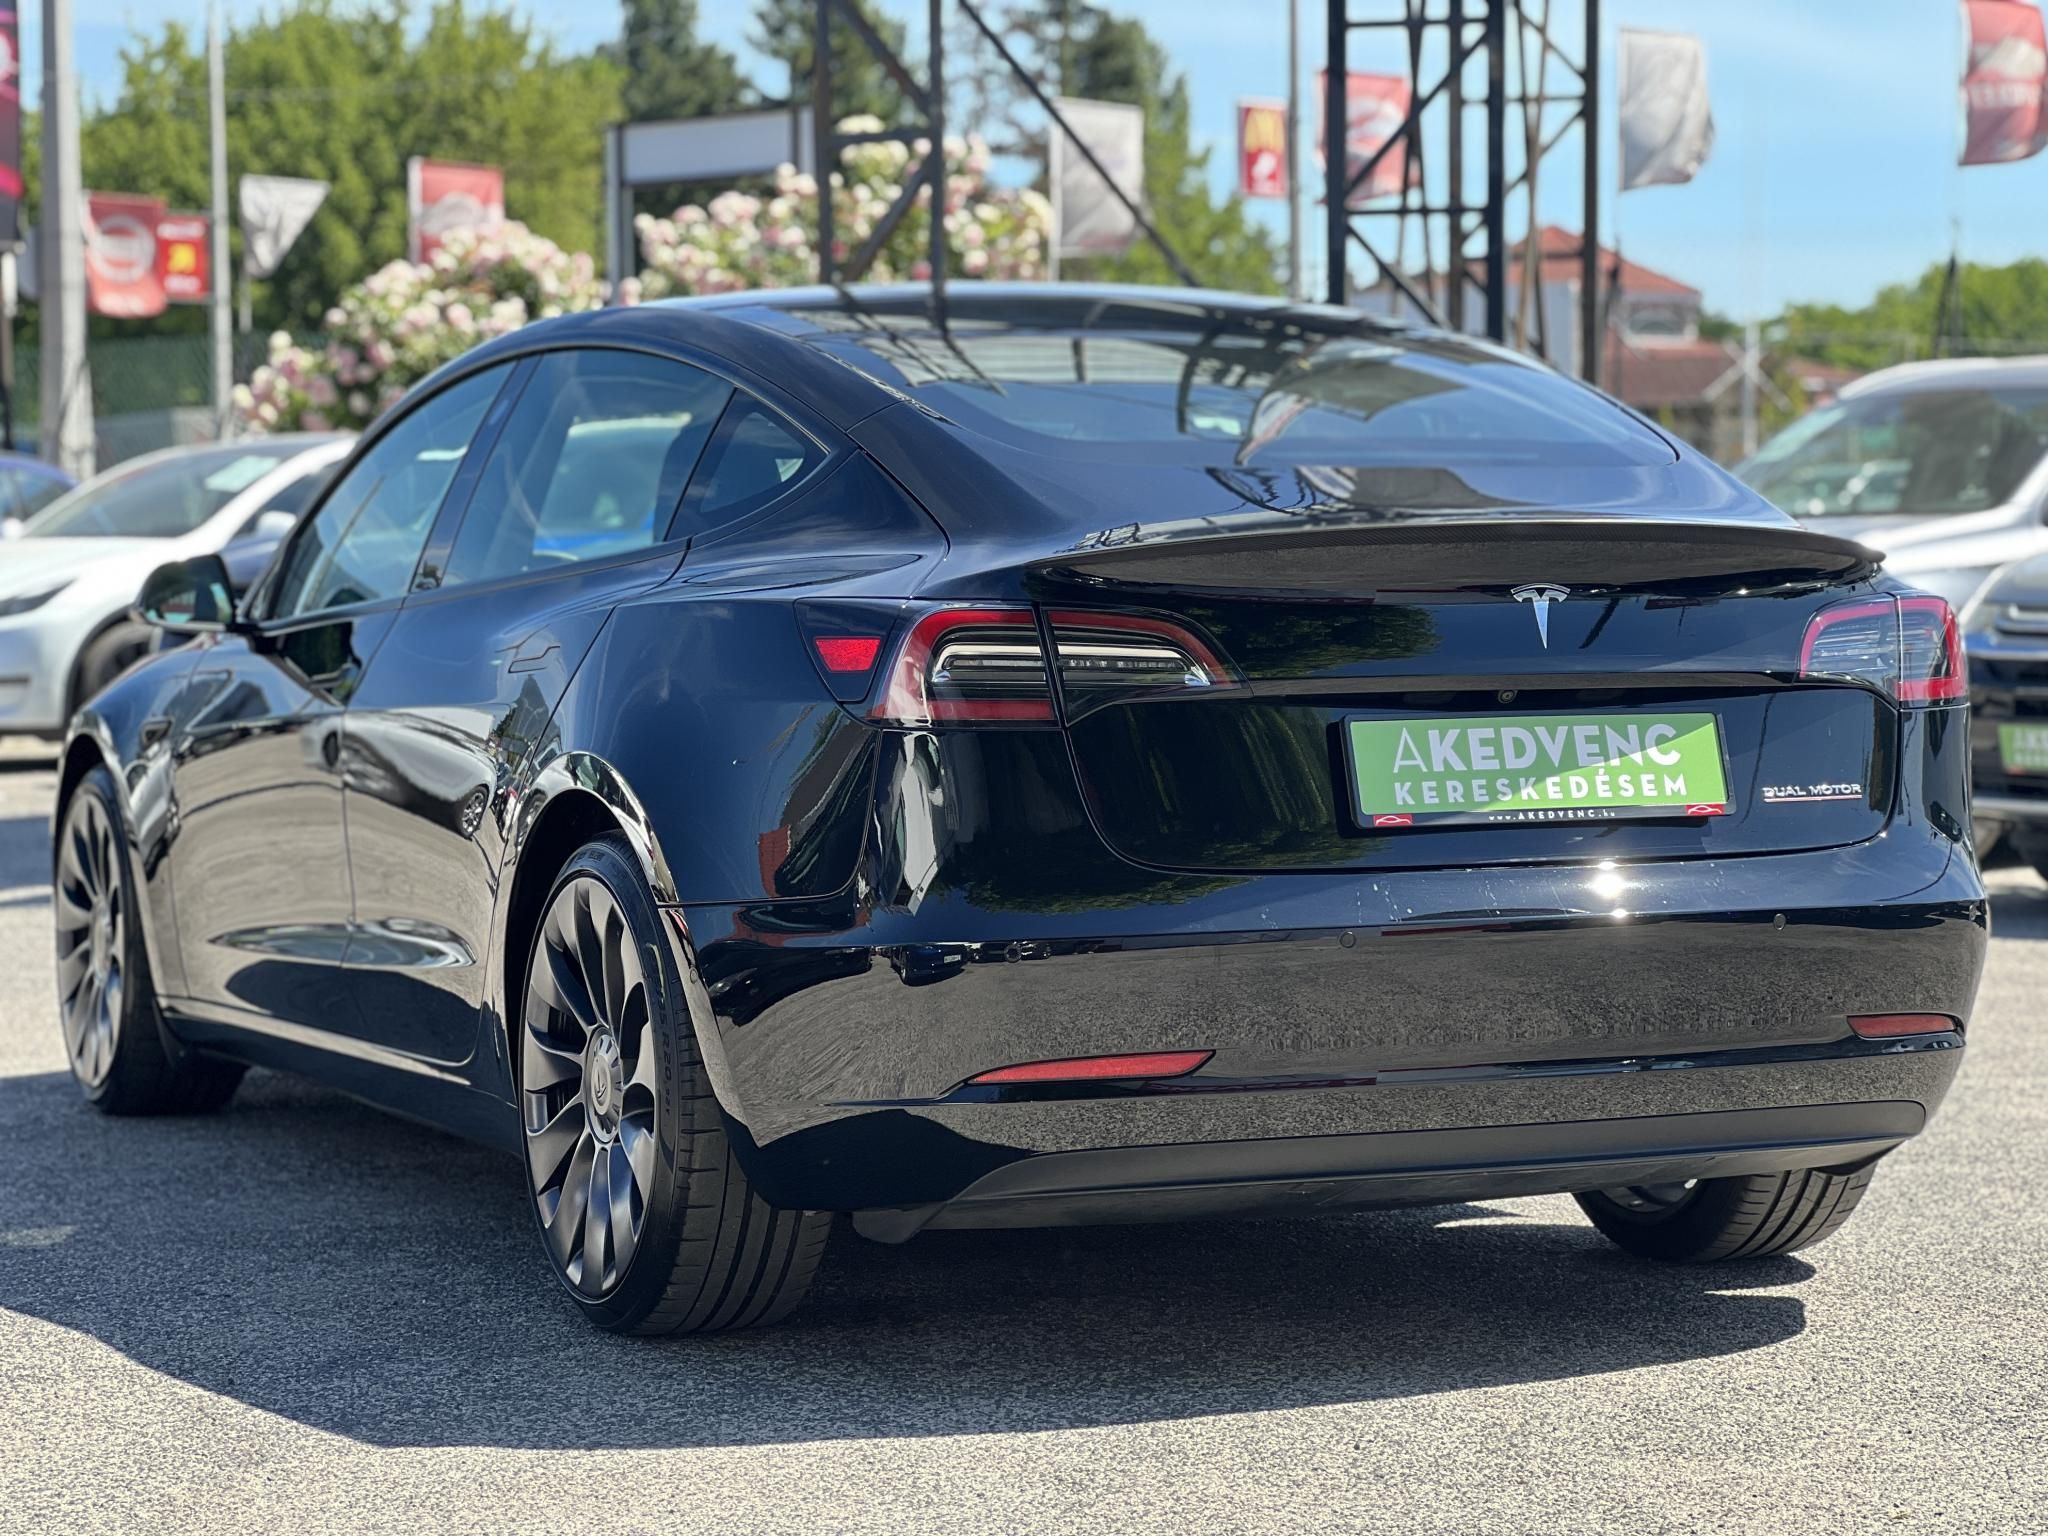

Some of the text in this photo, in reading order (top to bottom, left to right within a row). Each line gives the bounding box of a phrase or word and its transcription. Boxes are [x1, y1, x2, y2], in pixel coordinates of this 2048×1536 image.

[1393, 769, 1688, 806] KERESKEDÉSEM
[1762, 784, 1862, 797] DUAL MOTOR
[1488, 808, 1616, 821] www.AKEDVENC.hu
